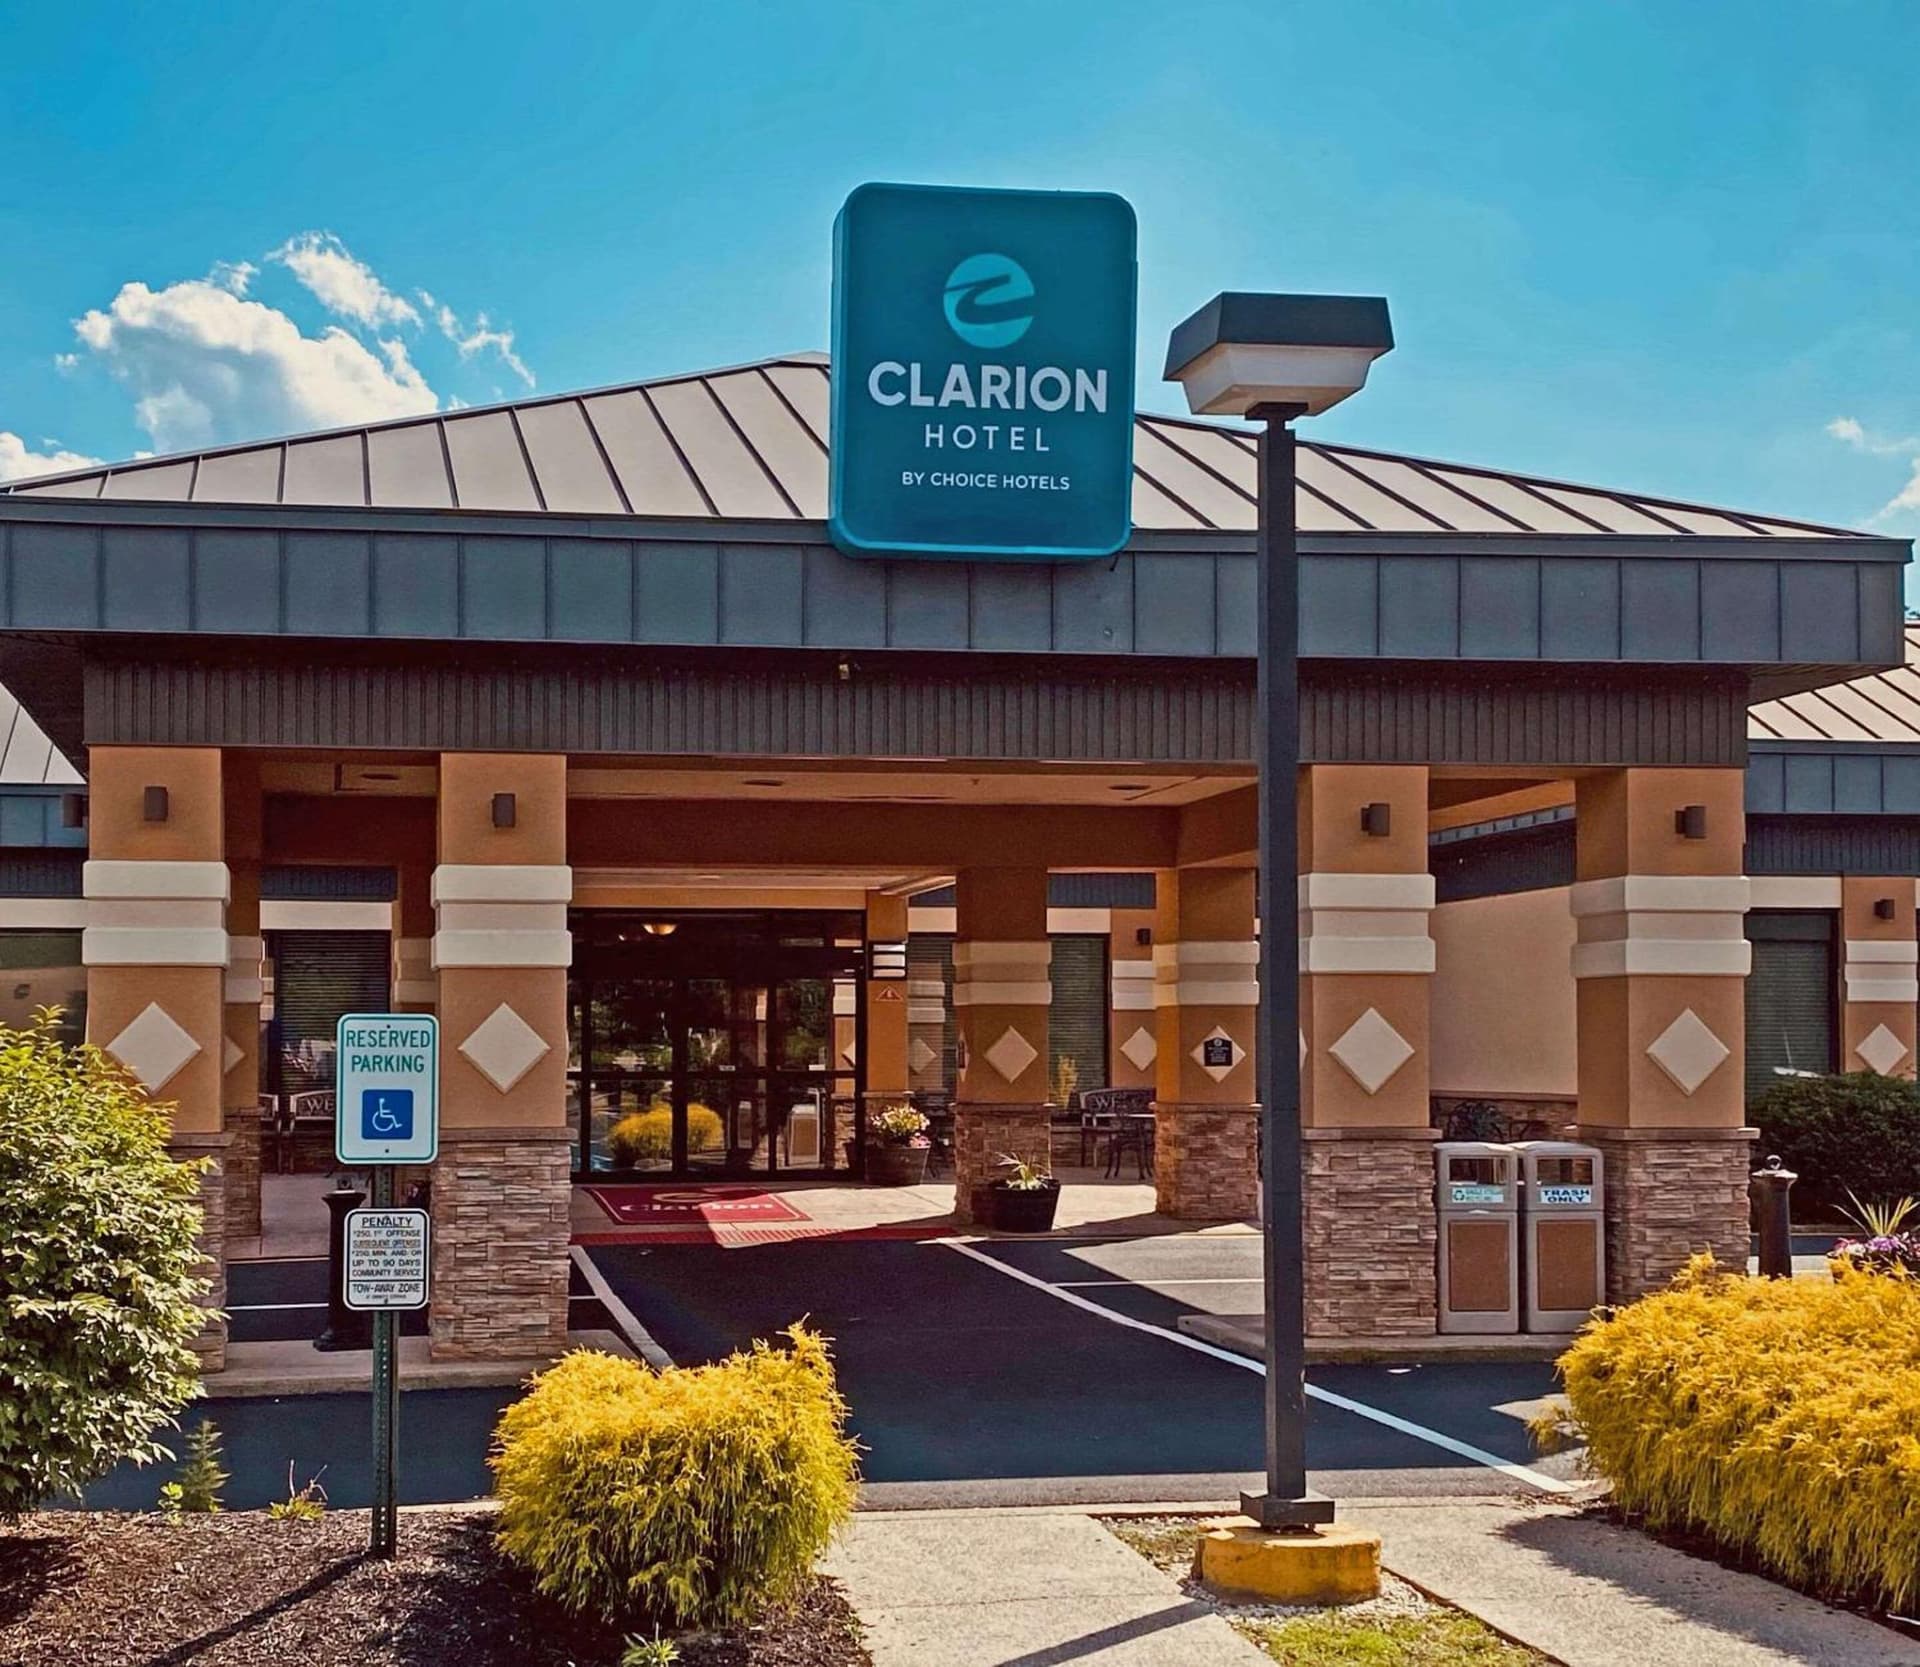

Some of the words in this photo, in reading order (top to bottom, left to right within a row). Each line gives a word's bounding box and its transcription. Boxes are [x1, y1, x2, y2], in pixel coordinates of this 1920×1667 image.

[867, 361, 1108, 413] CLARION
[924, 424, 1050, 451] HOTEL
[902, 471, 926, 486] BY
[930, 472, 998, 488] CHOICE
[1002, 475, 1070, 491] HOTELS
[346, 1029, 431, 1048] RESERVED
[351, 1054, 425, 1073] PARKING
[1543, 1189, 1590, 1197] TRASH
[361, 1216, 413, 1227] PENALTY
[386, 1229, 421, 1238] OFFENSE
[352, 1258, 365, 1267] UP
[368, 1258, 380, 1267] TO
[383, 1258, 396, 1267] 90
[398, 1258, 421, 1267] DAYS
[352, 1269, 391, 1277] COMMUNITY
[394, 1268, 421, 1276] SERVICE
[352, 1283, 396, 1293] TOW-AWAY
[398, 1283, 421, 1293] ZONE
